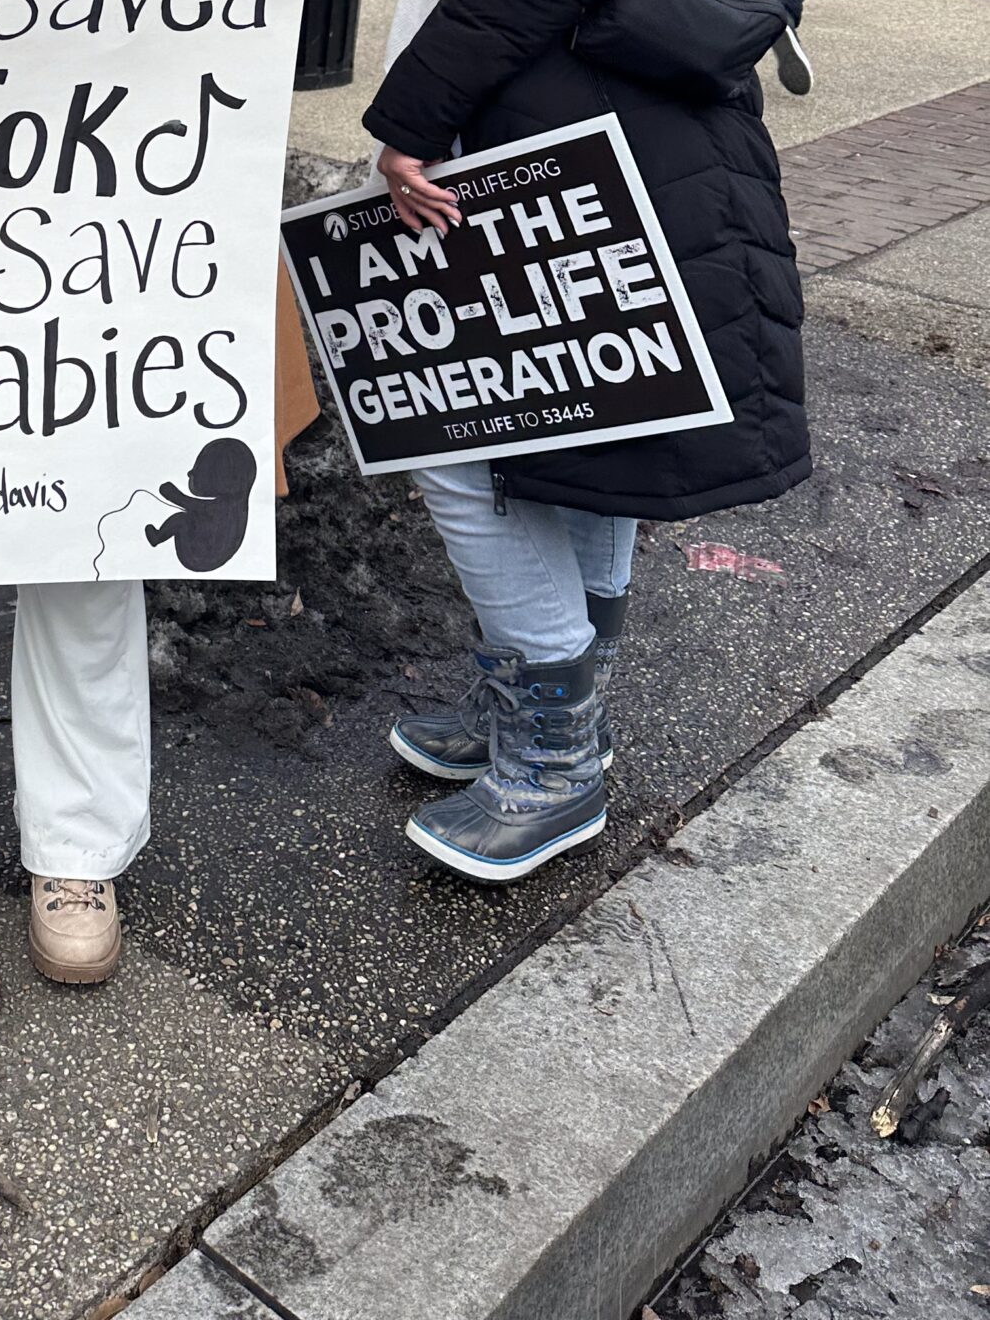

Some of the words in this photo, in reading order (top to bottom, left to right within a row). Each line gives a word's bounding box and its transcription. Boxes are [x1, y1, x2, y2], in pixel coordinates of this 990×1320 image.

[309, 256, 332, 297] I
[359, 226, 449, 288] AM
[467, 183, 612, 256] THE
[314, 237, 668, 369] PRO-LIFE
[349, 322, 682, 424] GENERATION
[443, 420, 478, 440] TEXT
[481, 415, 515, 434] LIFE
[515, 412, 539, 429] TO
[542, 402, 595, 425] 53445
